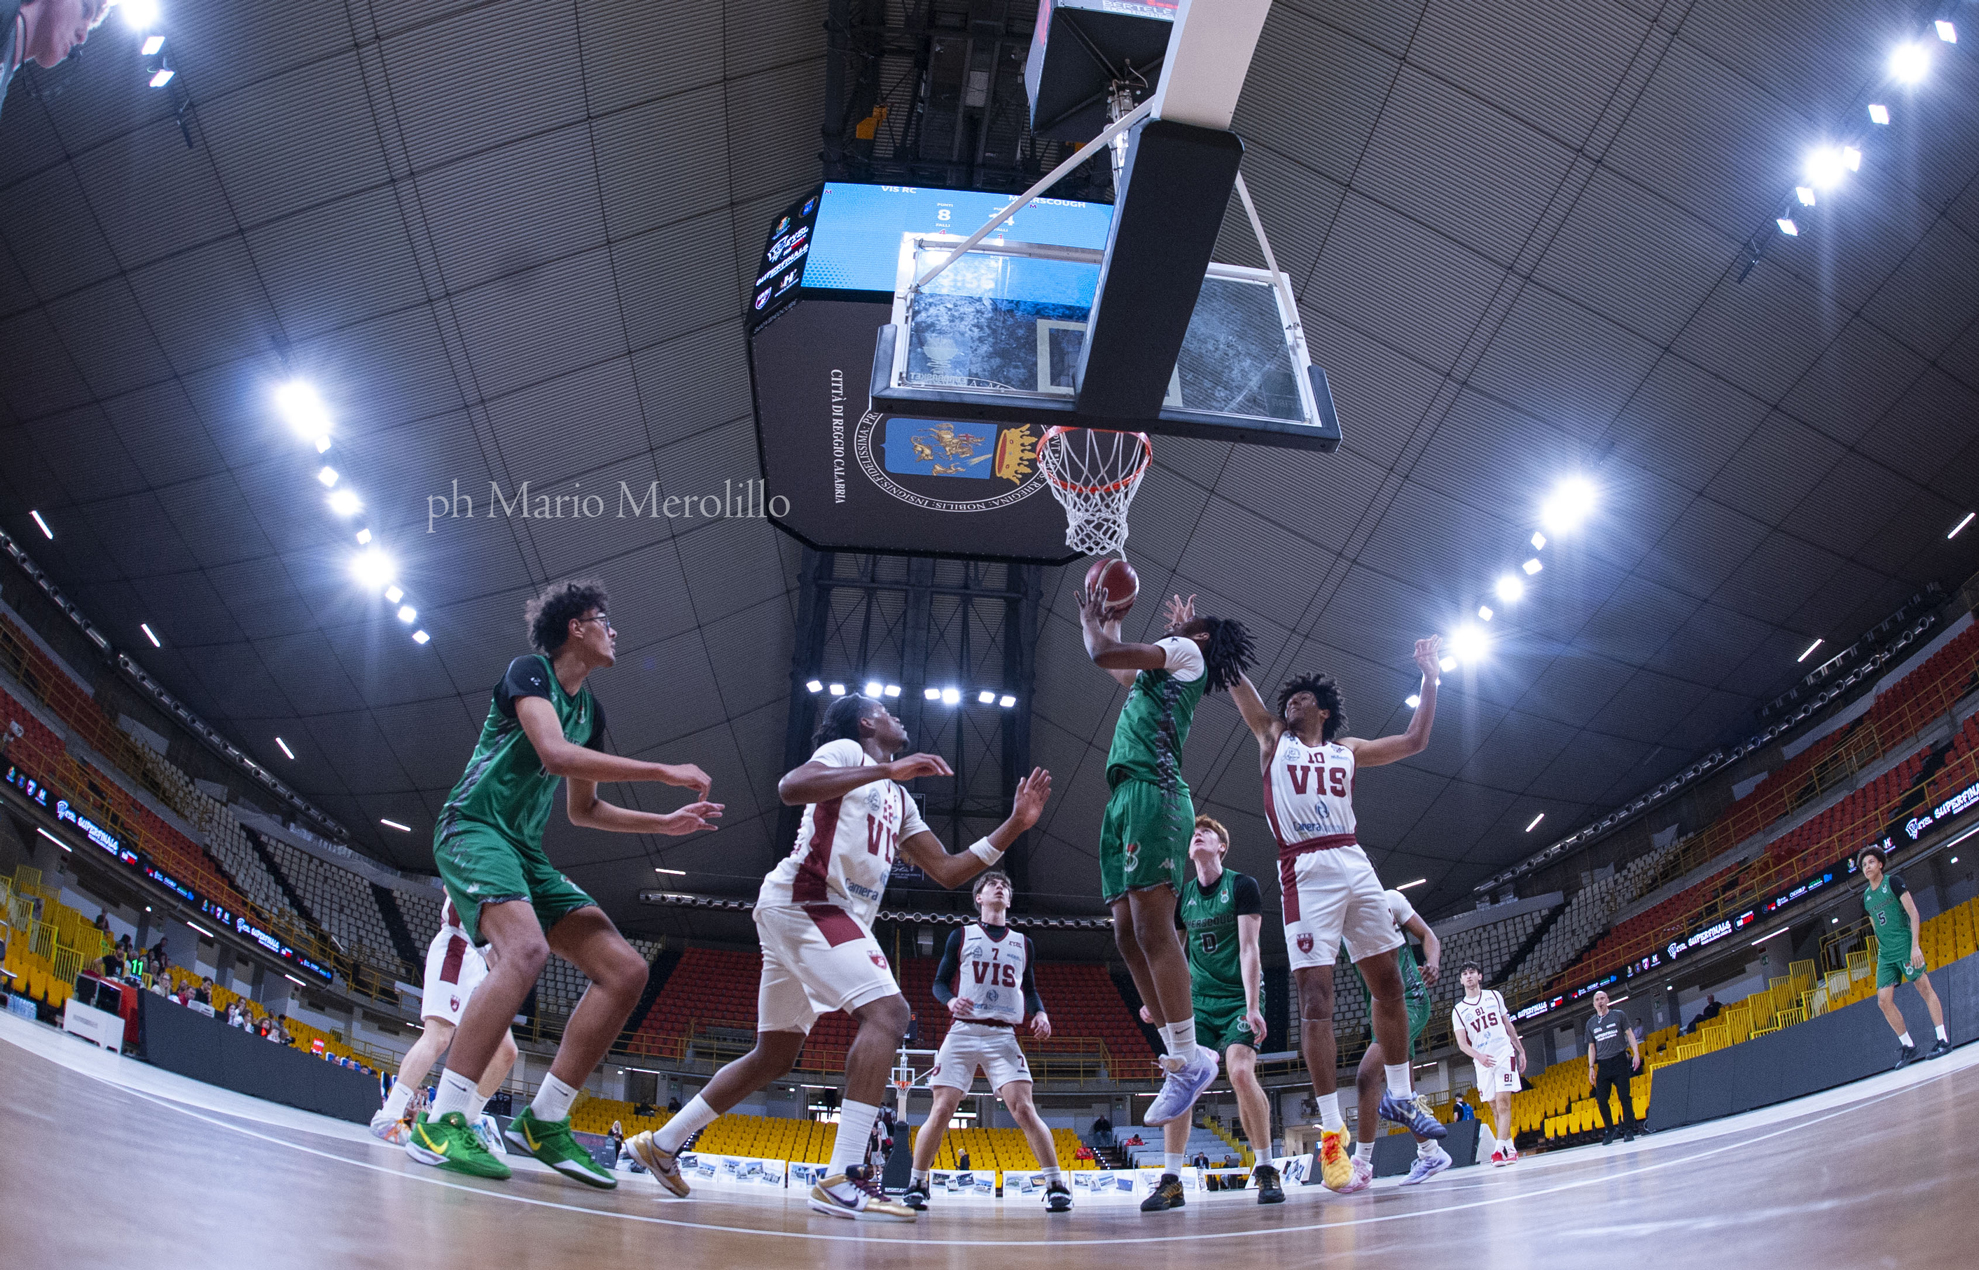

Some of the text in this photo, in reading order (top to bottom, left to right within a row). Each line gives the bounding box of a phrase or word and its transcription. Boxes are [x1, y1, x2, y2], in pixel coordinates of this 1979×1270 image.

[902, 186, 917, 194] RC
[937, 209, 951, 221] 8
[830, 368, 847, 504] CITTÀ DI REGGIO CALABRIA
[1307, 751, 1326, 764] 10
[1286, 764, 1347, 798] VIS
[866, 812, 899, 865] VI
[844, 877, 879, 901] Camera
[1876, 910, 1887, 926] 5
[991, 947, 999, 961] 7
[131, 959, 144, 976] 11
[972, 960, 1016, 988] VIS
[1474, 1006, 1485, 1016] 81
[1470, 1012, 1499, 1033] VIS
[1503, 1073, 1513, 1083] 81
